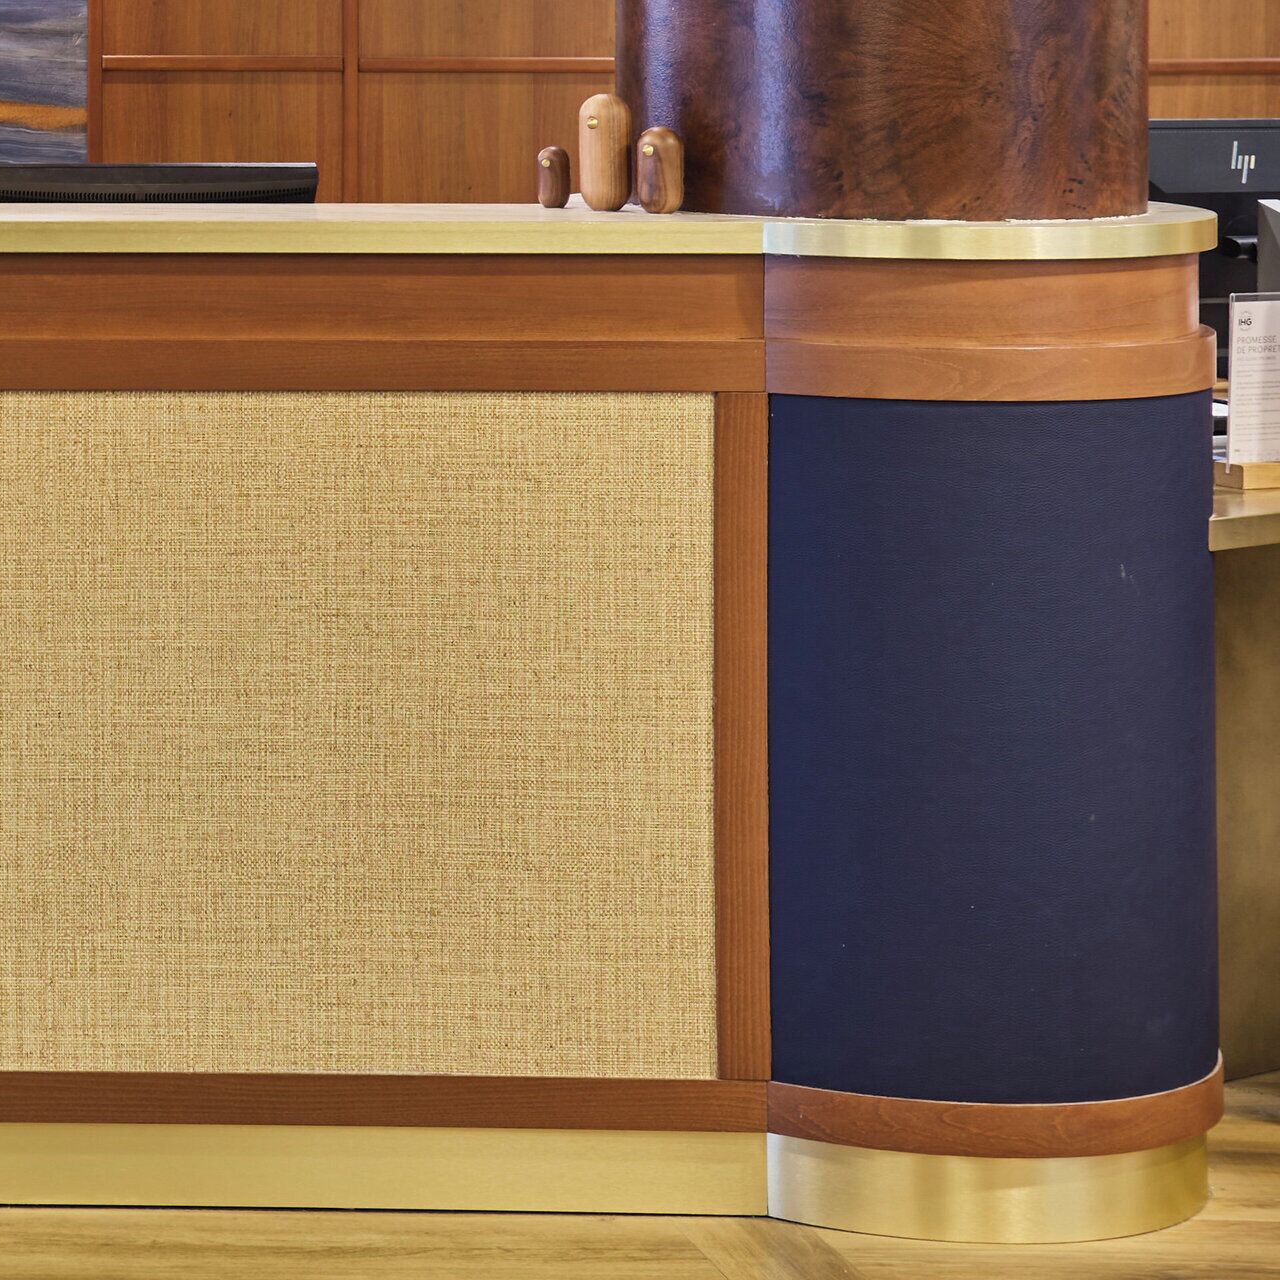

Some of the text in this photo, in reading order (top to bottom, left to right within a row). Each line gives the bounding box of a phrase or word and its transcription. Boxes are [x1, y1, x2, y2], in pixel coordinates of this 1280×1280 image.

[1230, 140, 1257, 185] hp
[1238, 318, 1253, 326] IHG
[1236, 335, 1277, 345] PROMESSE
[1236, 345, 1246, 354] DE
